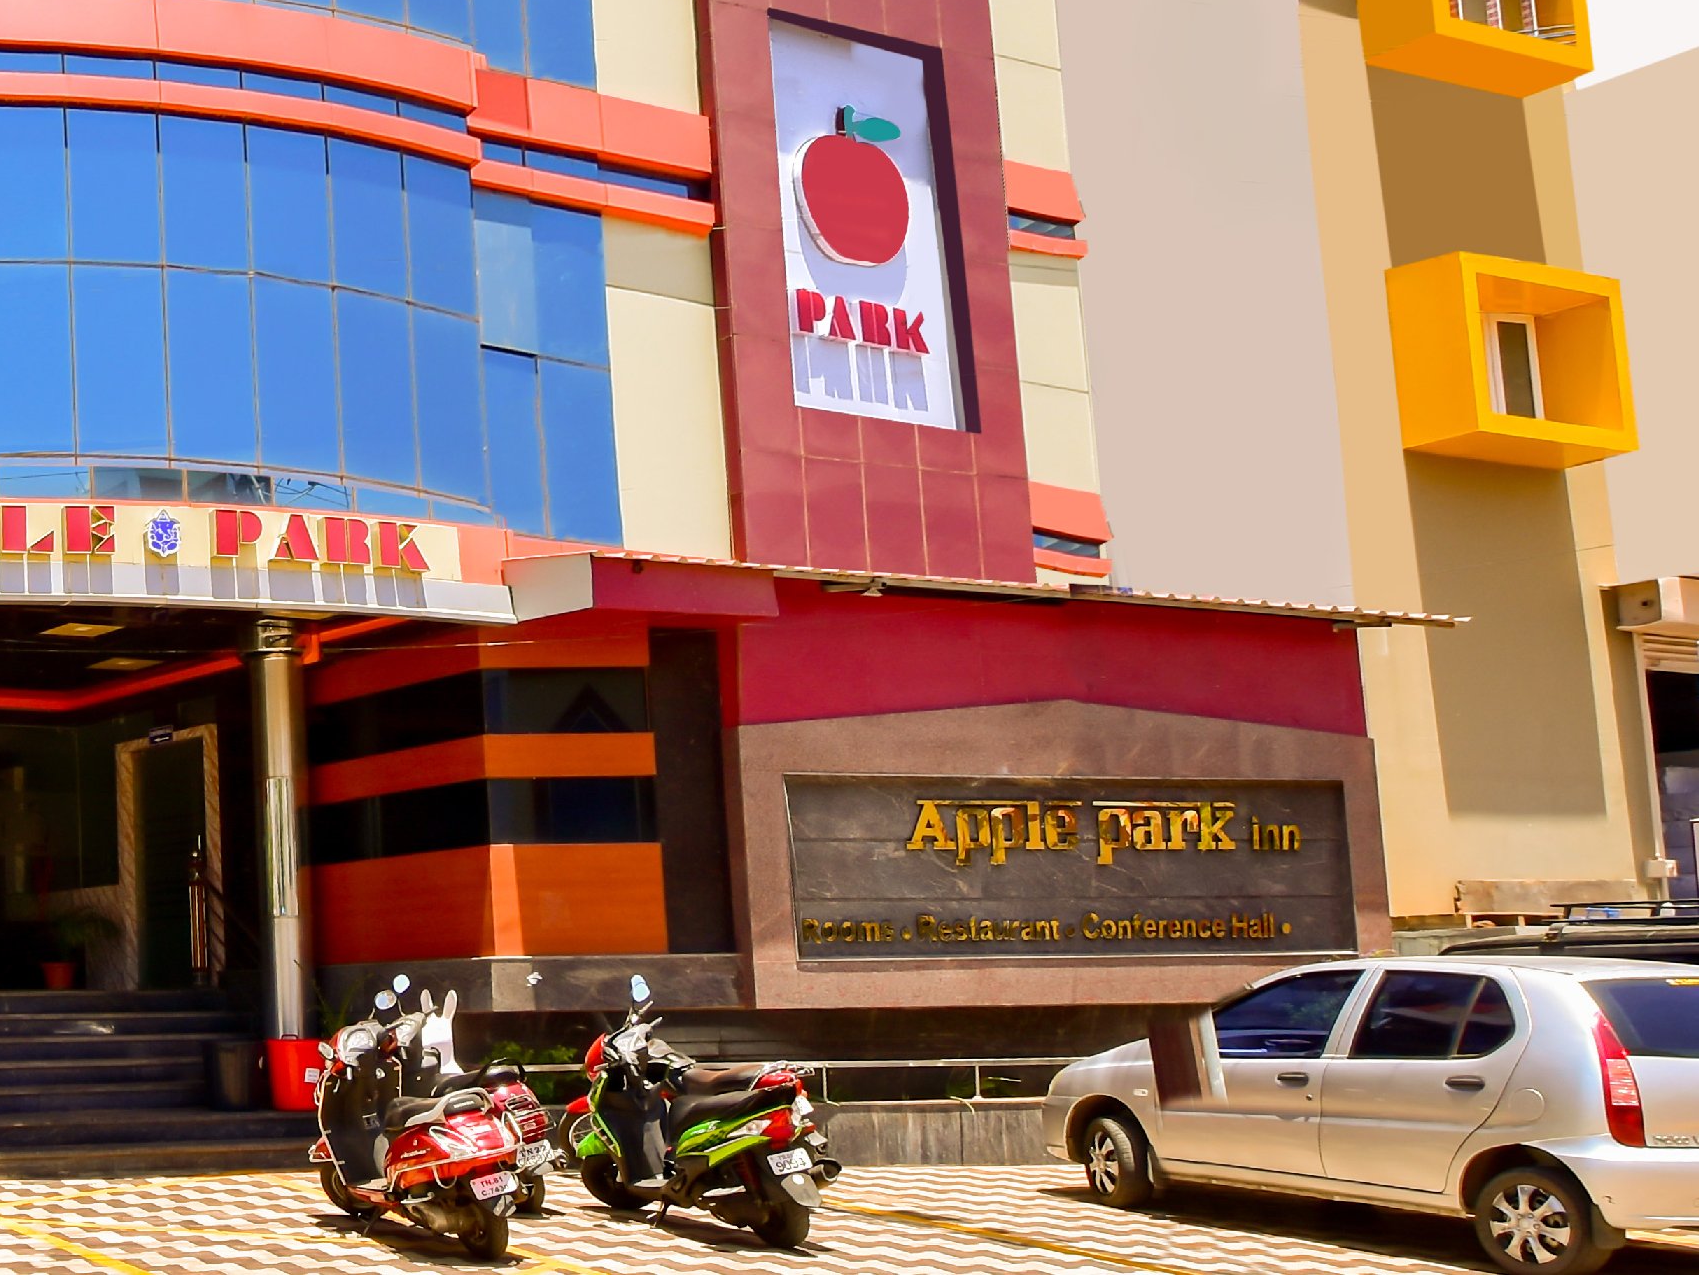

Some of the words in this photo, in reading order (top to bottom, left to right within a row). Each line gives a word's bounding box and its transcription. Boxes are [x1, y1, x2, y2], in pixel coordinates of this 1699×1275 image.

[793, 288, 931, 355] PARK
[211, 509, 431, 573] PARK
[906, 799, 1083, 865] Apple
[1092, 800, 1236, 865] park
[1251, 815, 1300, 851] inn
[801, 917, 895, 944] Rooms
[916, 913, 1061, 943] Restaurant
[1082, 911, 1227, 939] Conference
[1231, 913, 1276, 938] Hall
